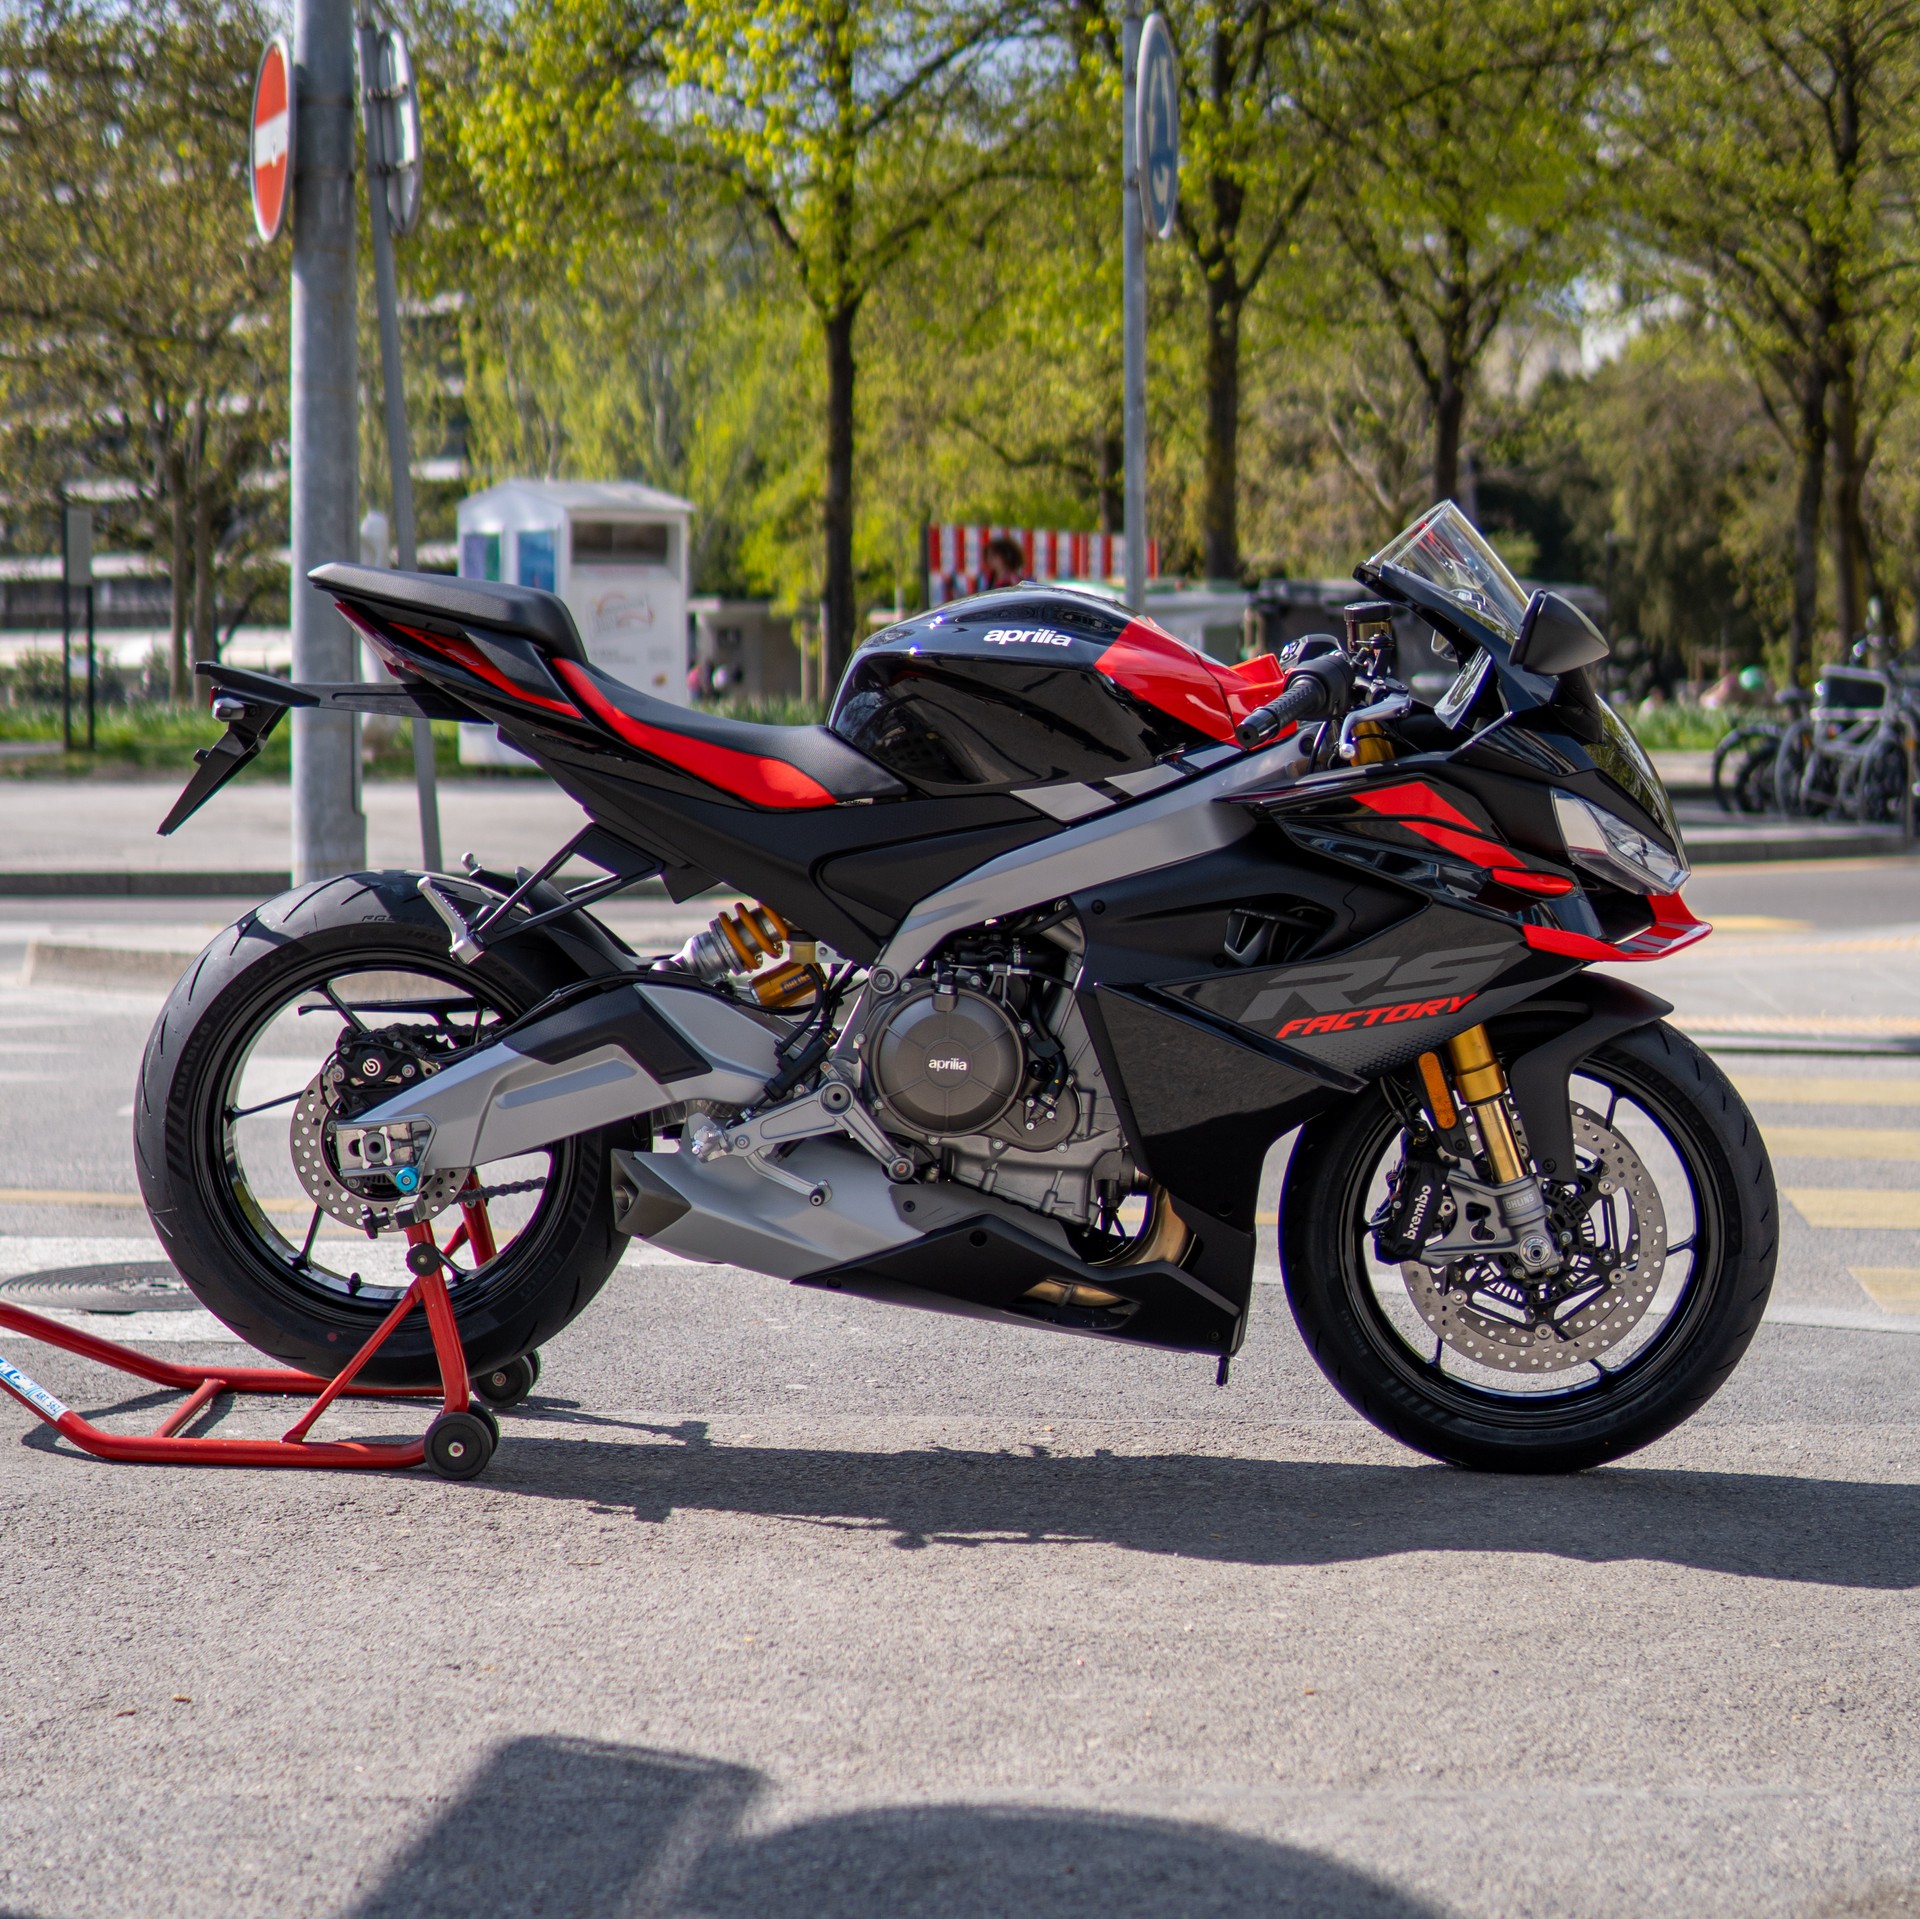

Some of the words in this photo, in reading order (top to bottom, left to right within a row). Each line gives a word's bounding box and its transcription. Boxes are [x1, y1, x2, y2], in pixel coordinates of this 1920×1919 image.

[983, 628, 1073, 647] aprilia
[1237, 941, 1520, 1023] RS
[1275, 993, 1479, 1039] FACTORY
[928, 1057, 967, 1072] aprilia
[1403, 1185, 1431, 1240] brembo
